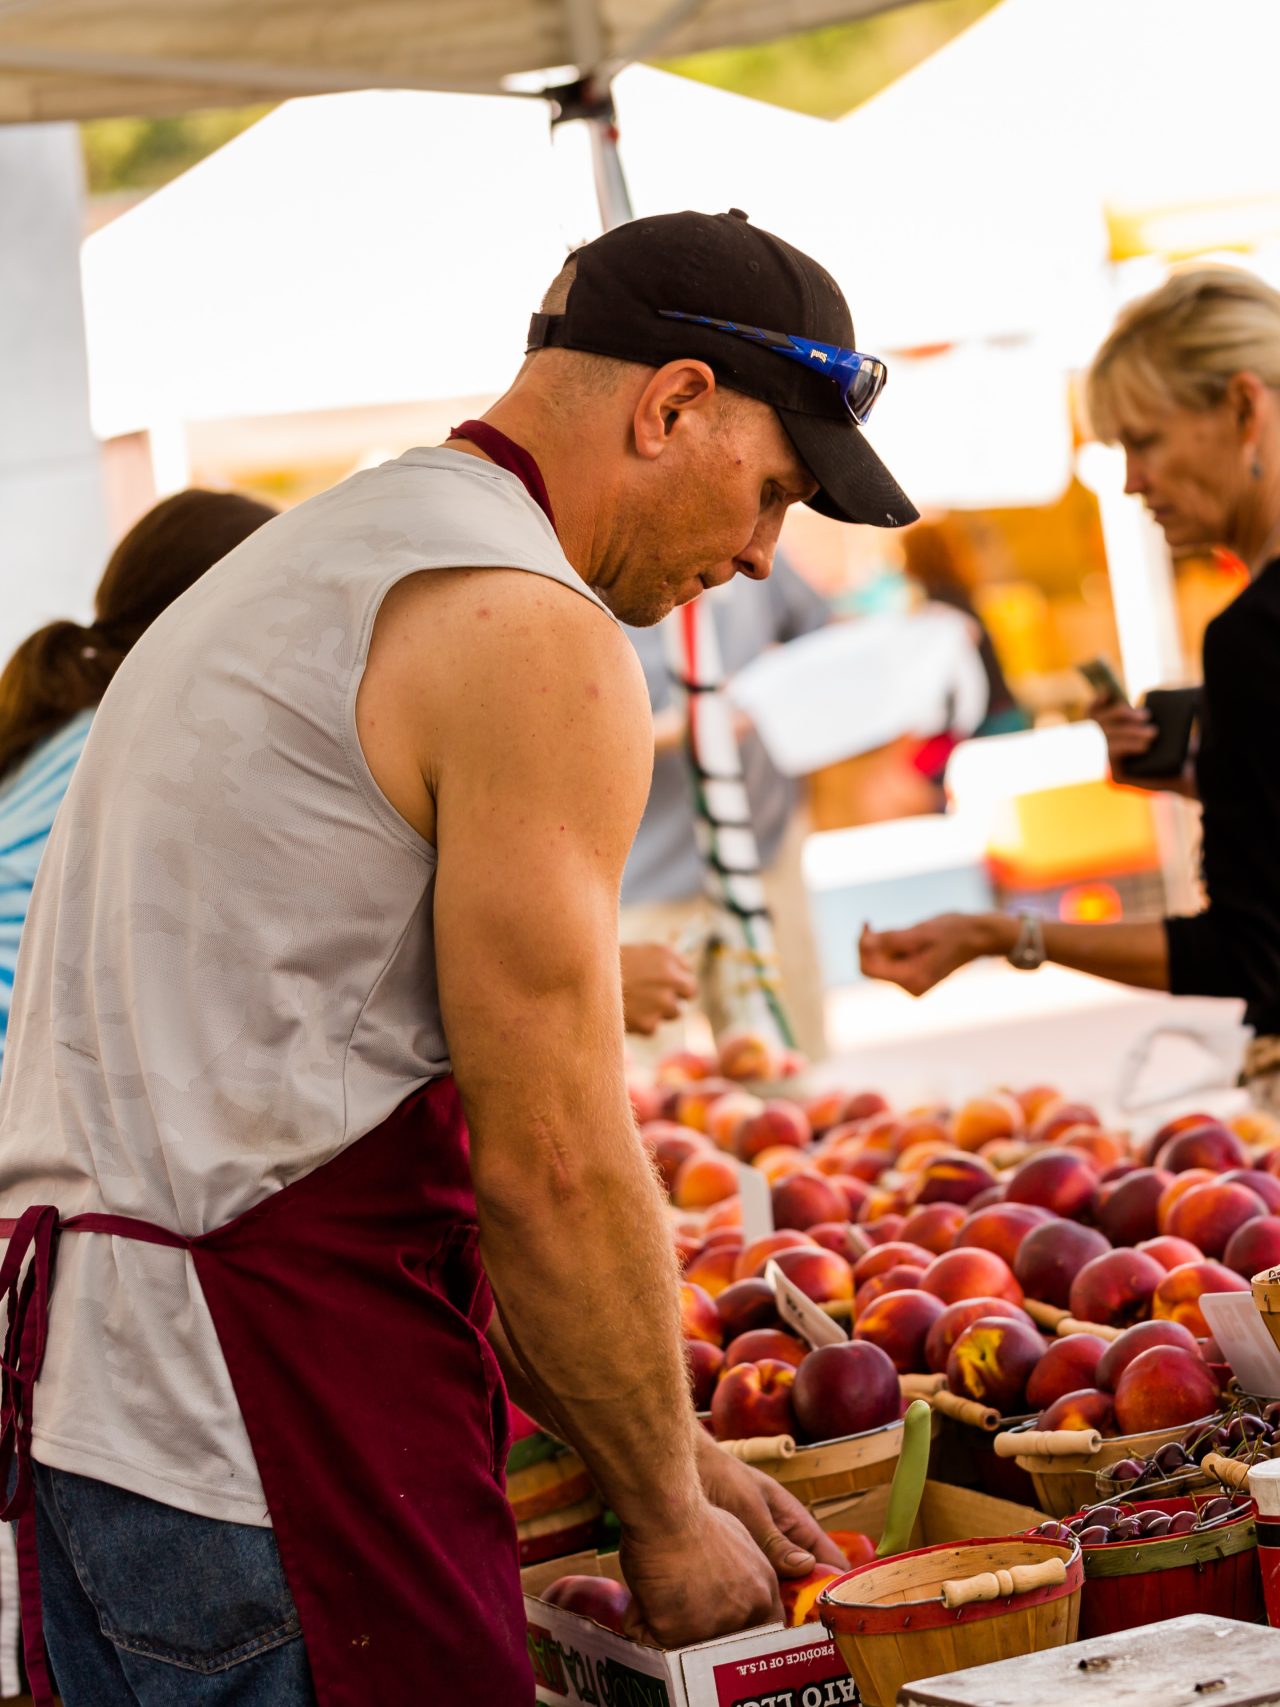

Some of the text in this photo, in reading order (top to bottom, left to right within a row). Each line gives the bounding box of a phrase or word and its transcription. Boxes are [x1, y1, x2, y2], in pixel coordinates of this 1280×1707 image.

[735, 1644, 836, 1676] PRODUCE OF U.S.A.
[802, 1677, 861, 1707] ATO
